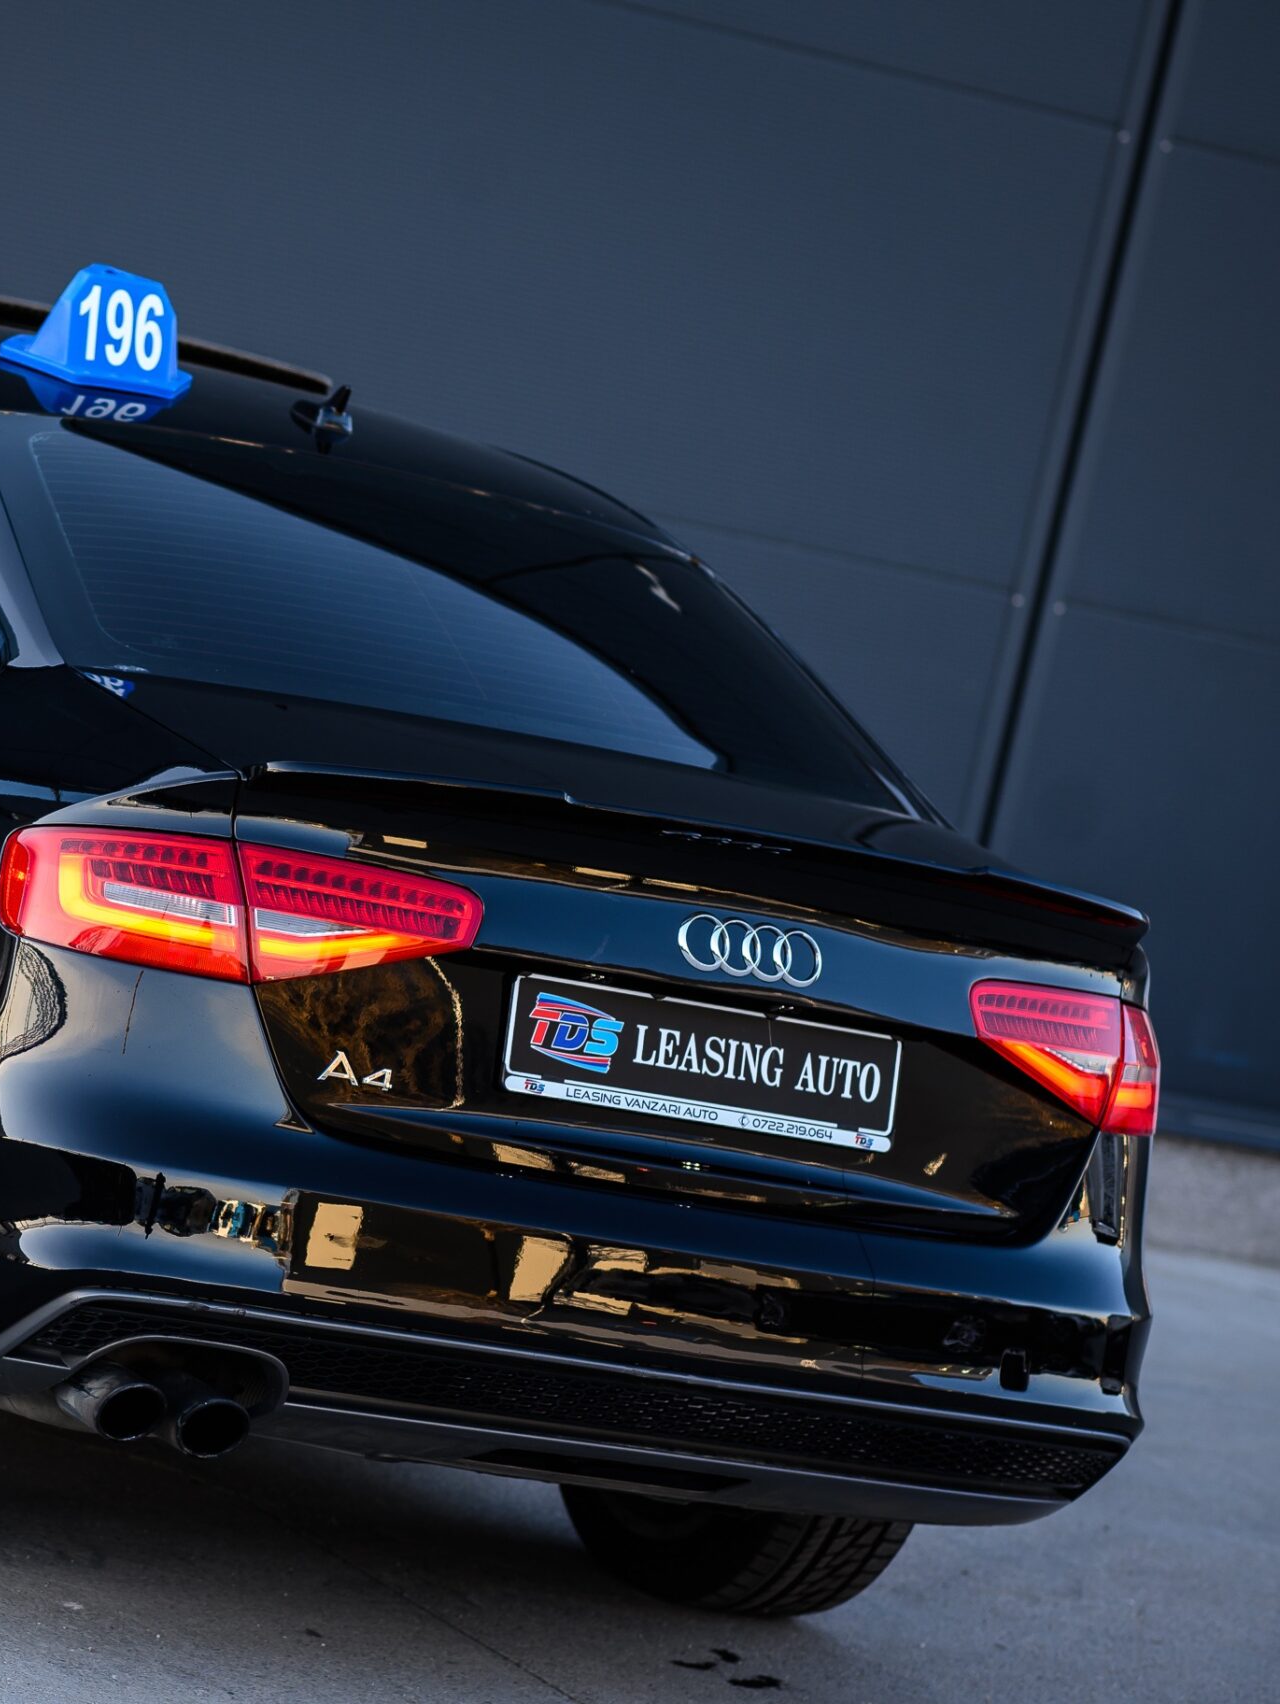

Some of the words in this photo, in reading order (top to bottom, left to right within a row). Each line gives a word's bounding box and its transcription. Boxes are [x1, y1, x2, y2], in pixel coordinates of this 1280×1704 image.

[79, 284, 164, 371] 196
[317, 1050, 393, 1091] A4
[529, 1010, 624, 1057] TDS
[632, 1024, 785, 1088] LEASING
[794, 1052, 881, 1103] AUTO
[524, 1080, 546, 1093] TDS
[565, 1087, 622, 1107] LEASING
[624, 1096, 681, 1114] VANZARI
[683, 1105, 719, 1121] AUTO
[752, 1118, 833, 1141] 0722.219.064
[854, 1134, 874, 1147] TDS
